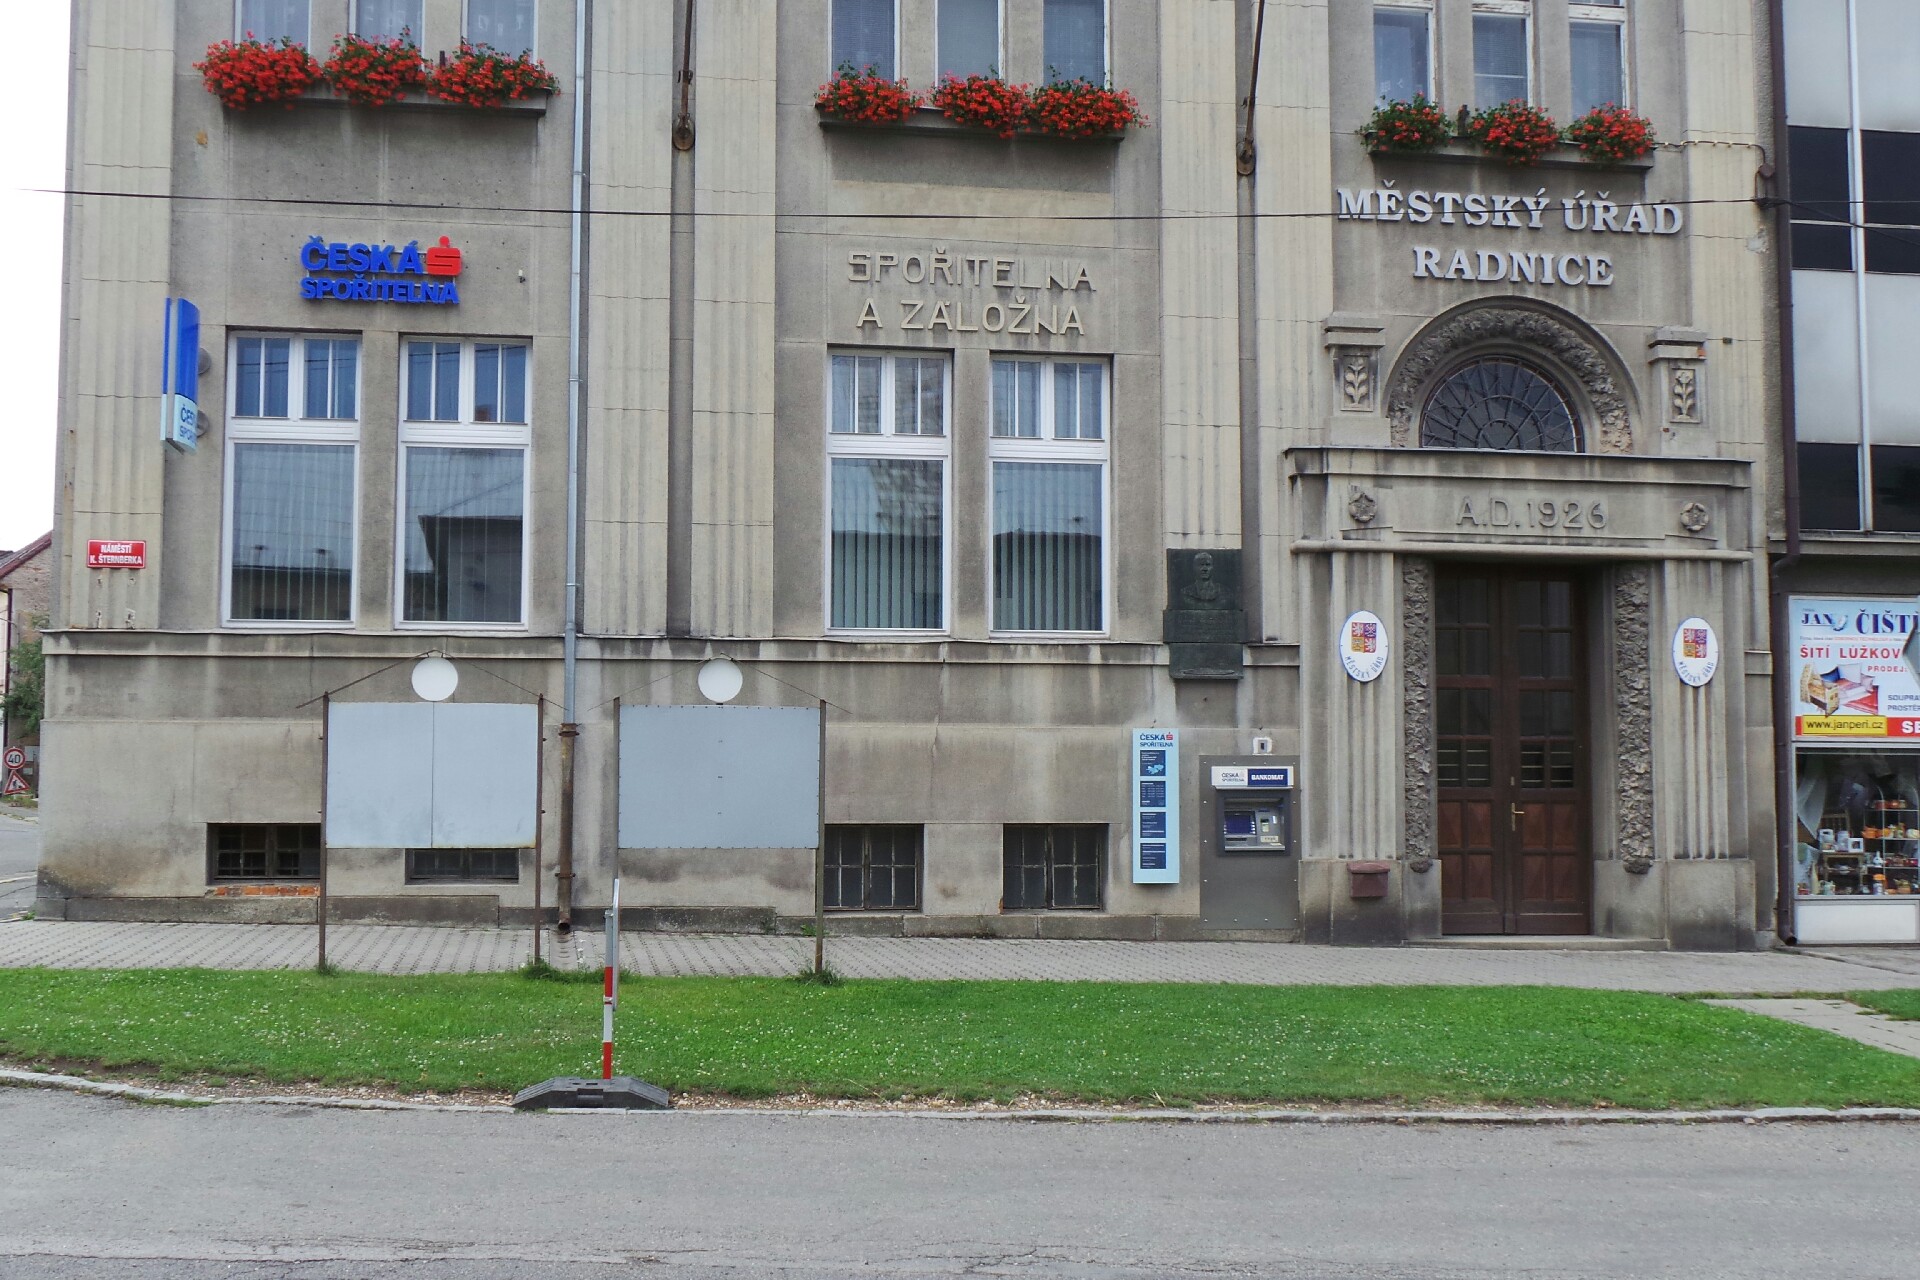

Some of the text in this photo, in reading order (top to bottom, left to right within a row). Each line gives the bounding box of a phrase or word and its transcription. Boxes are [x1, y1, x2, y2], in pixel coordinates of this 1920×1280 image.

[1336, 179, 1684, 235] MĚSTSKÝ ÚŘAD
[301, 235, 423, 273] ČESKÁ
[1413, 246, 1615, 287] RADNICE
[848, 247, 1097, 292] SPOŘITELNA
[300, 273, 460, 304] SPOŘITELNA
[856, 295, 1085, 335] A ZÁLOŽNA
[1527, 501, 1607, 529] 1926
[89, 553, 142, 564] K. ŠTERNBERKA
[100, 543, 132, 554] NÁMĚSTÍ
[1801, 613, 1834, 625] JAN
[1800, 645, 1830, 659] ŠITÍ
[1345, 656, 1370, 679] MĚSTSKÝ
[1867, 665, 1907, 673] PRODEJ:
[8, 754, 20, 763] 40
